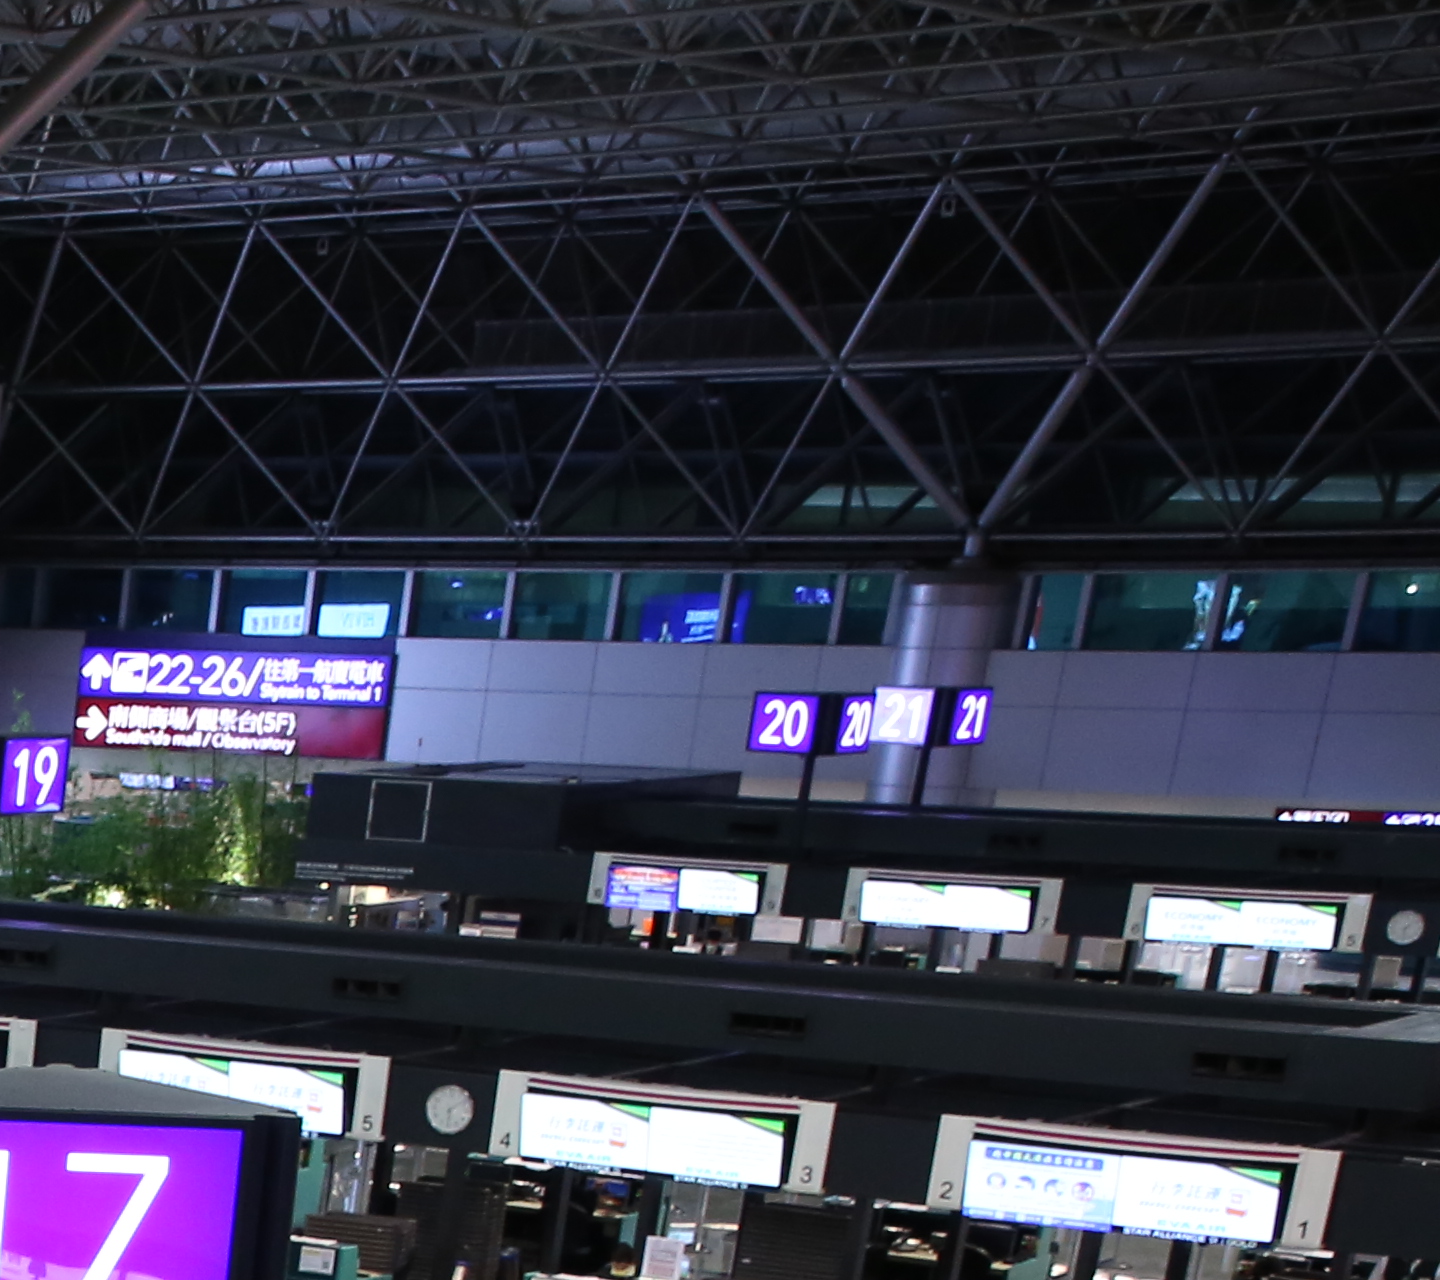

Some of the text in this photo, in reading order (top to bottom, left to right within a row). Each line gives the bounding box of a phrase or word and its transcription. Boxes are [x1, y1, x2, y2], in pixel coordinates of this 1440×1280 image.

[306, 687, 317, 700] to
[319, 684, 372, 702] Terminal
[374, 687, 382, 702] 1
[758, 699, 809, 747] 20
[840, 700, 872, 747] 20
[879, 693, 924, 739] 21
[955, 694, 987, 739] 21
[173, 731, 201, 748] mall
[211, 733, 296, 755] Observatory
[13, 746, 60, 807] 19
[362, 1115, 373, 1132] 5
[499, 1132, 511, 1149] 4
[800, 1166, 813, 1184] 3
[939, 1182, 954, 1200] 2
[1122, 1226, 1151, 1238] STAR
[1152, 1230, 1207, 1244] ALLIANCE
[1156, 1219, 1226, 1233] EVA AIR
[1297, 1221, 1309, 1240] 1
